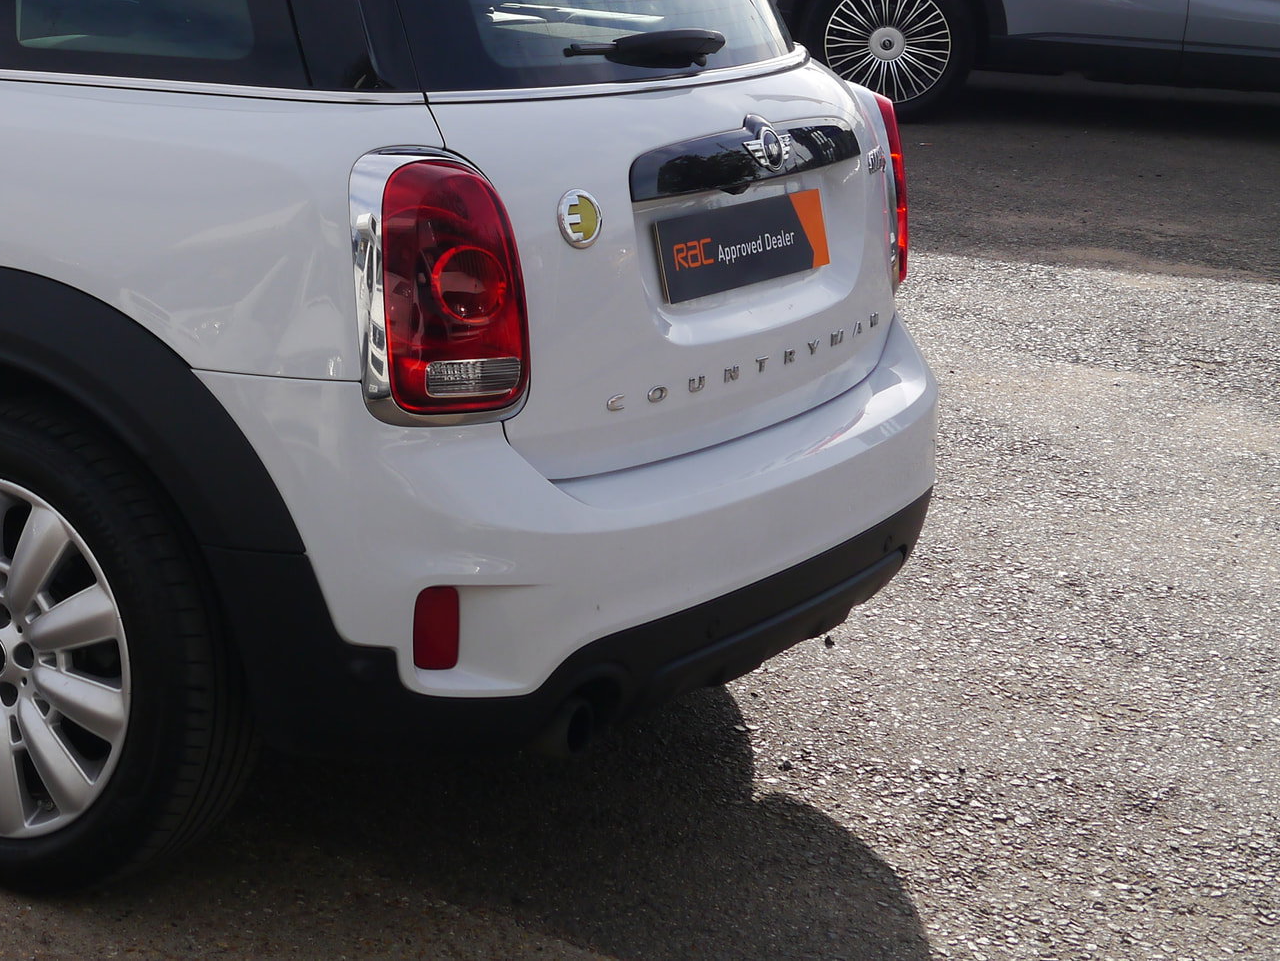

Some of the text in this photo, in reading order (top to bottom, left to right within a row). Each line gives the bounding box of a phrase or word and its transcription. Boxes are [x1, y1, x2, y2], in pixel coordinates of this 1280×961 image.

[718, 235, 763, 265] Approved
[765, 229, 795, 251] Dealer
[606, 311, 880, 412] COUNTRYMAN
